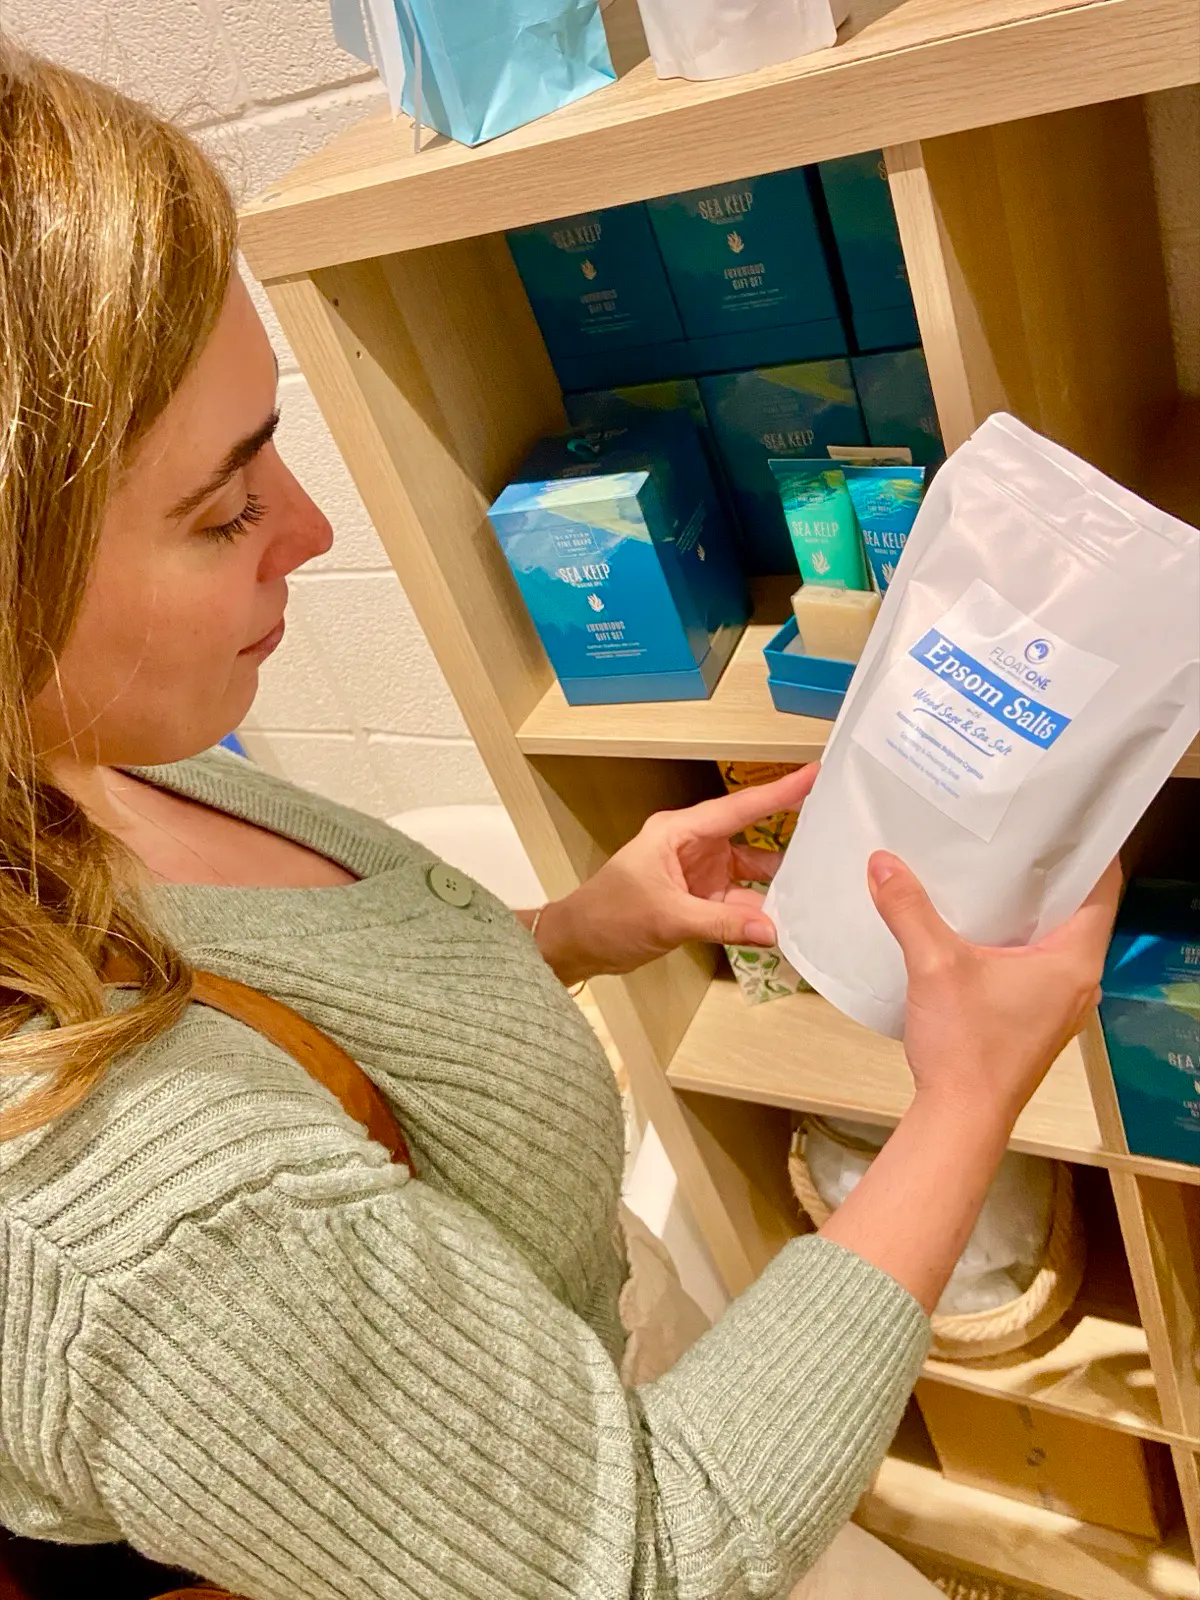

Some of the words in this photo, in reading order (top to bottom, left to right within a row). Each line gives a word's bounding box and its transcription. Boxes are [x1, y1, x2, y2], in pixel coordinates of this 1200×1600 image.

[699, 198, 724, 219] SEA
[724, 192, 753, 215] KELP
[763, 433, 787, 450] SEA
[787, 429, 814, 448] KELP
[791, 521, 812, 537] SEA
[813, 521, 839, 538] KELP
[862, 529, 881, 548] SEA
[881, 532, 907, 549] KELP
[558, 566, 583, 583] SEA
[582, 563, 611, 581] KELP
[923, 637, 1004, 708] Epsom
[1003, 698, 1058, 741] Salts
[912, 687, 945, 711] Wood
[938, 706, 962, 724] Sage
[960, 719, 975, 733] &
[970, 726, 989, 743] Sea
[988, 738, 1012, 757] Salt
